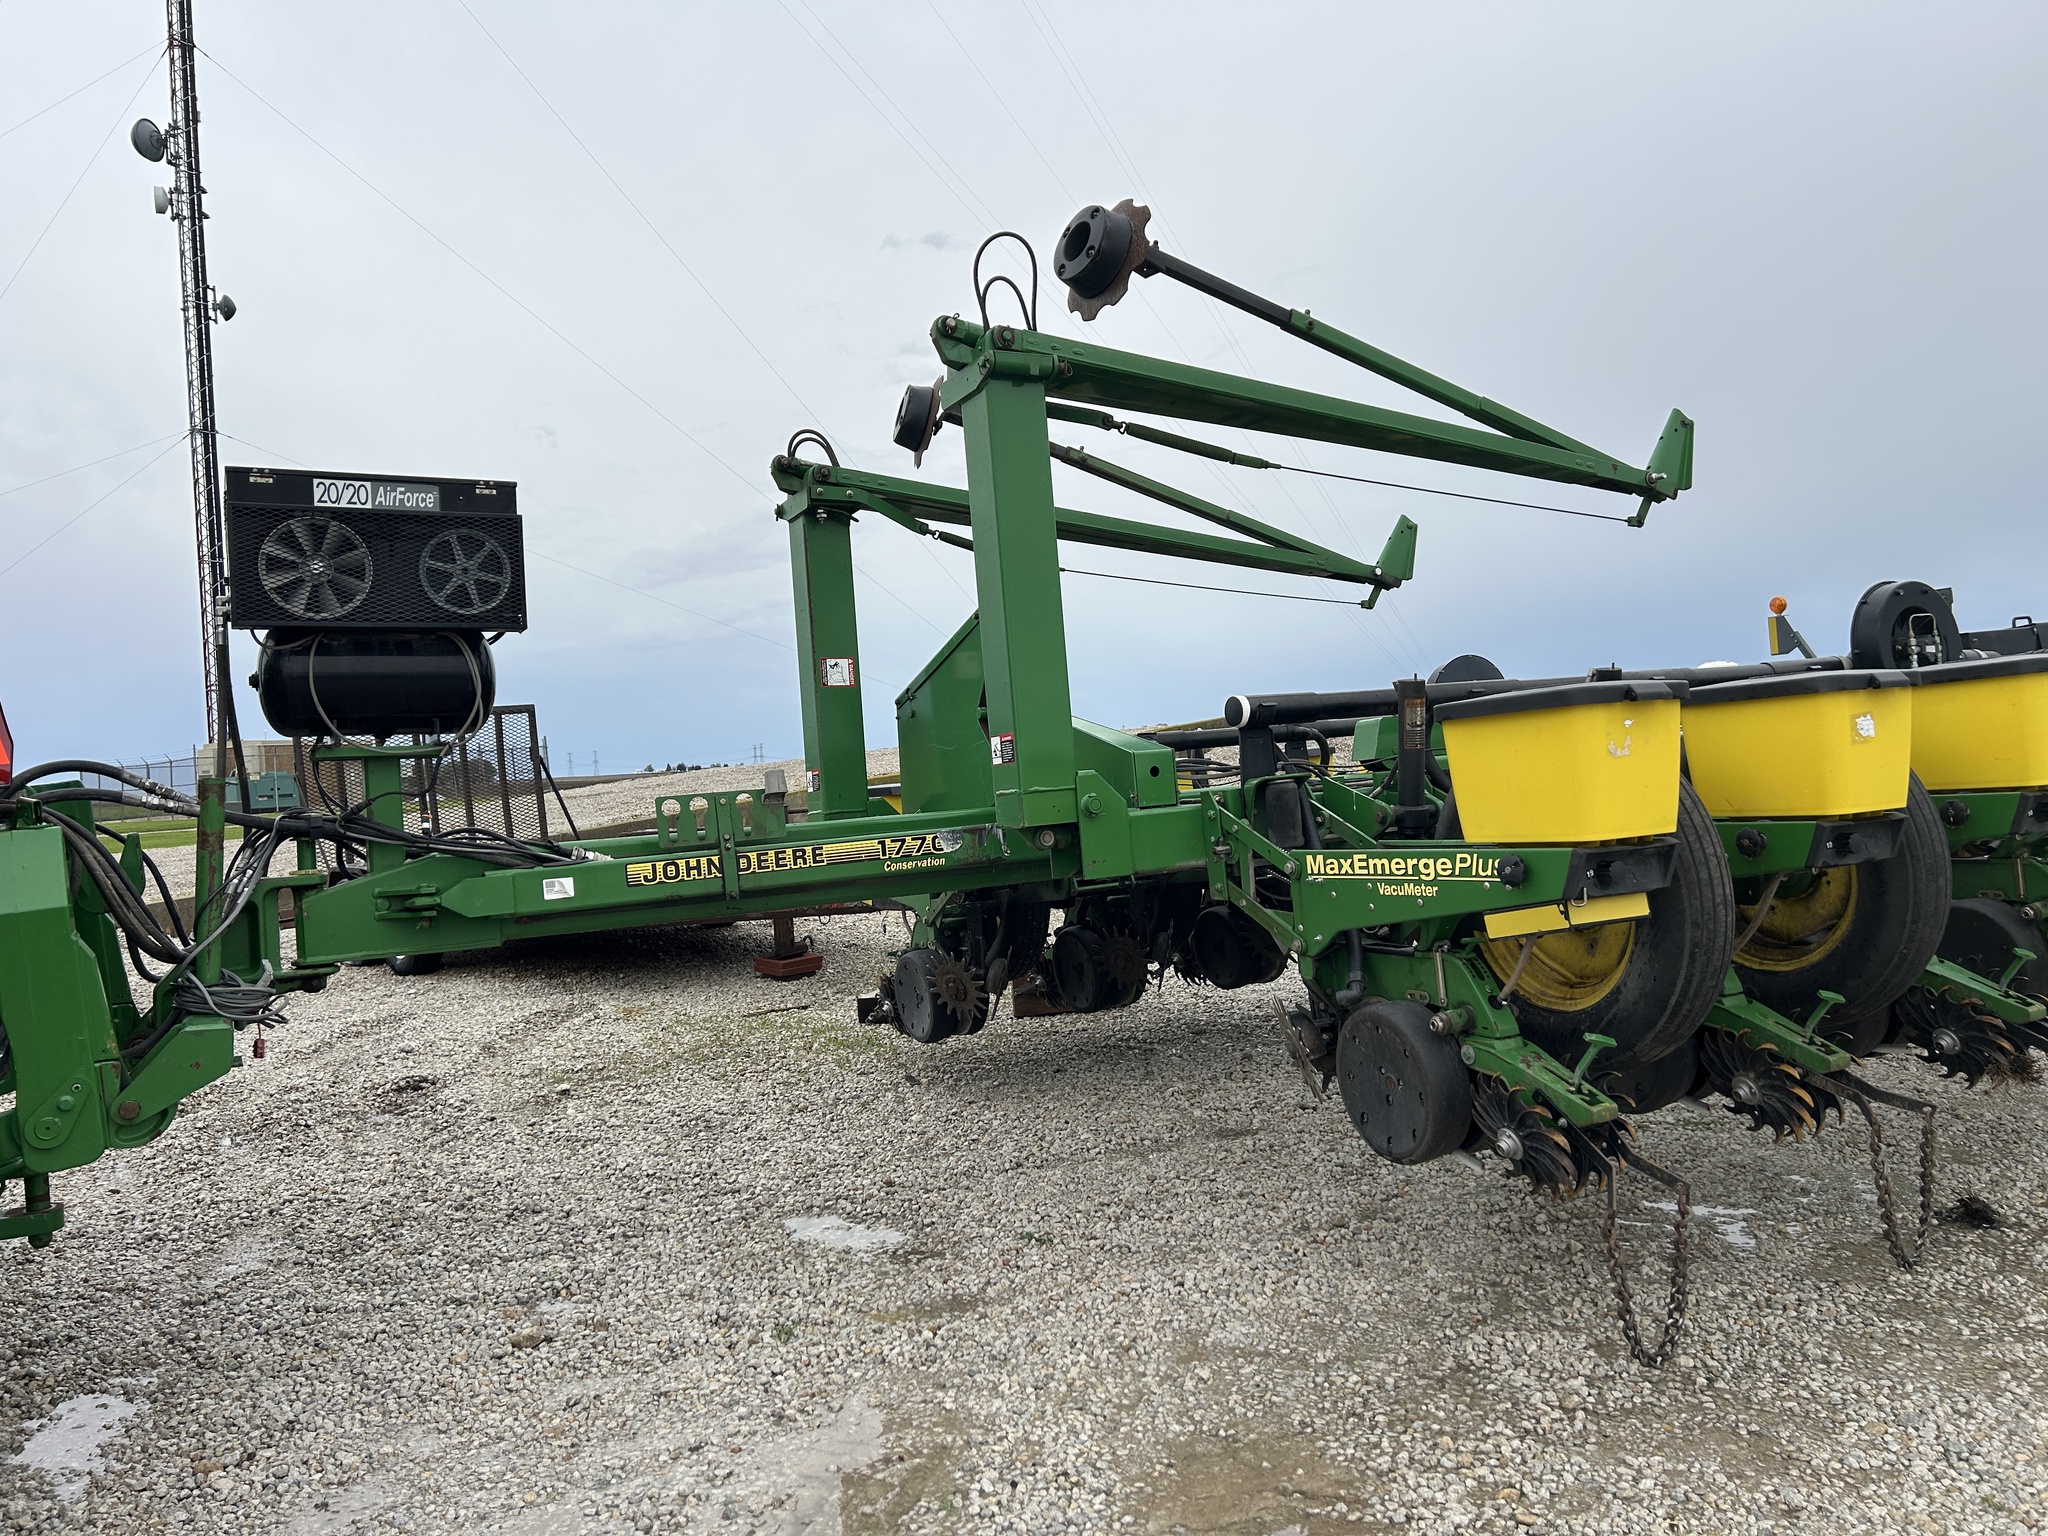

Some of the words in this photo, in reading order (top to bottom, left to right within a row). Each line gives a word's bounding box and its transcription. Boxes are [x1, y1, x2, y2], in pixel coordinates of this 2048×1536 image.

[315, 481, 369, 506] 20/20
[375, 486, 434, 507] AirForce
[642, 856, 722, 884] JOHN
[737, 846, 827, 874] DEERE
[884, 857, 946, 872] Conservation
[1377, 883, 1438, 897] VacuMeter
